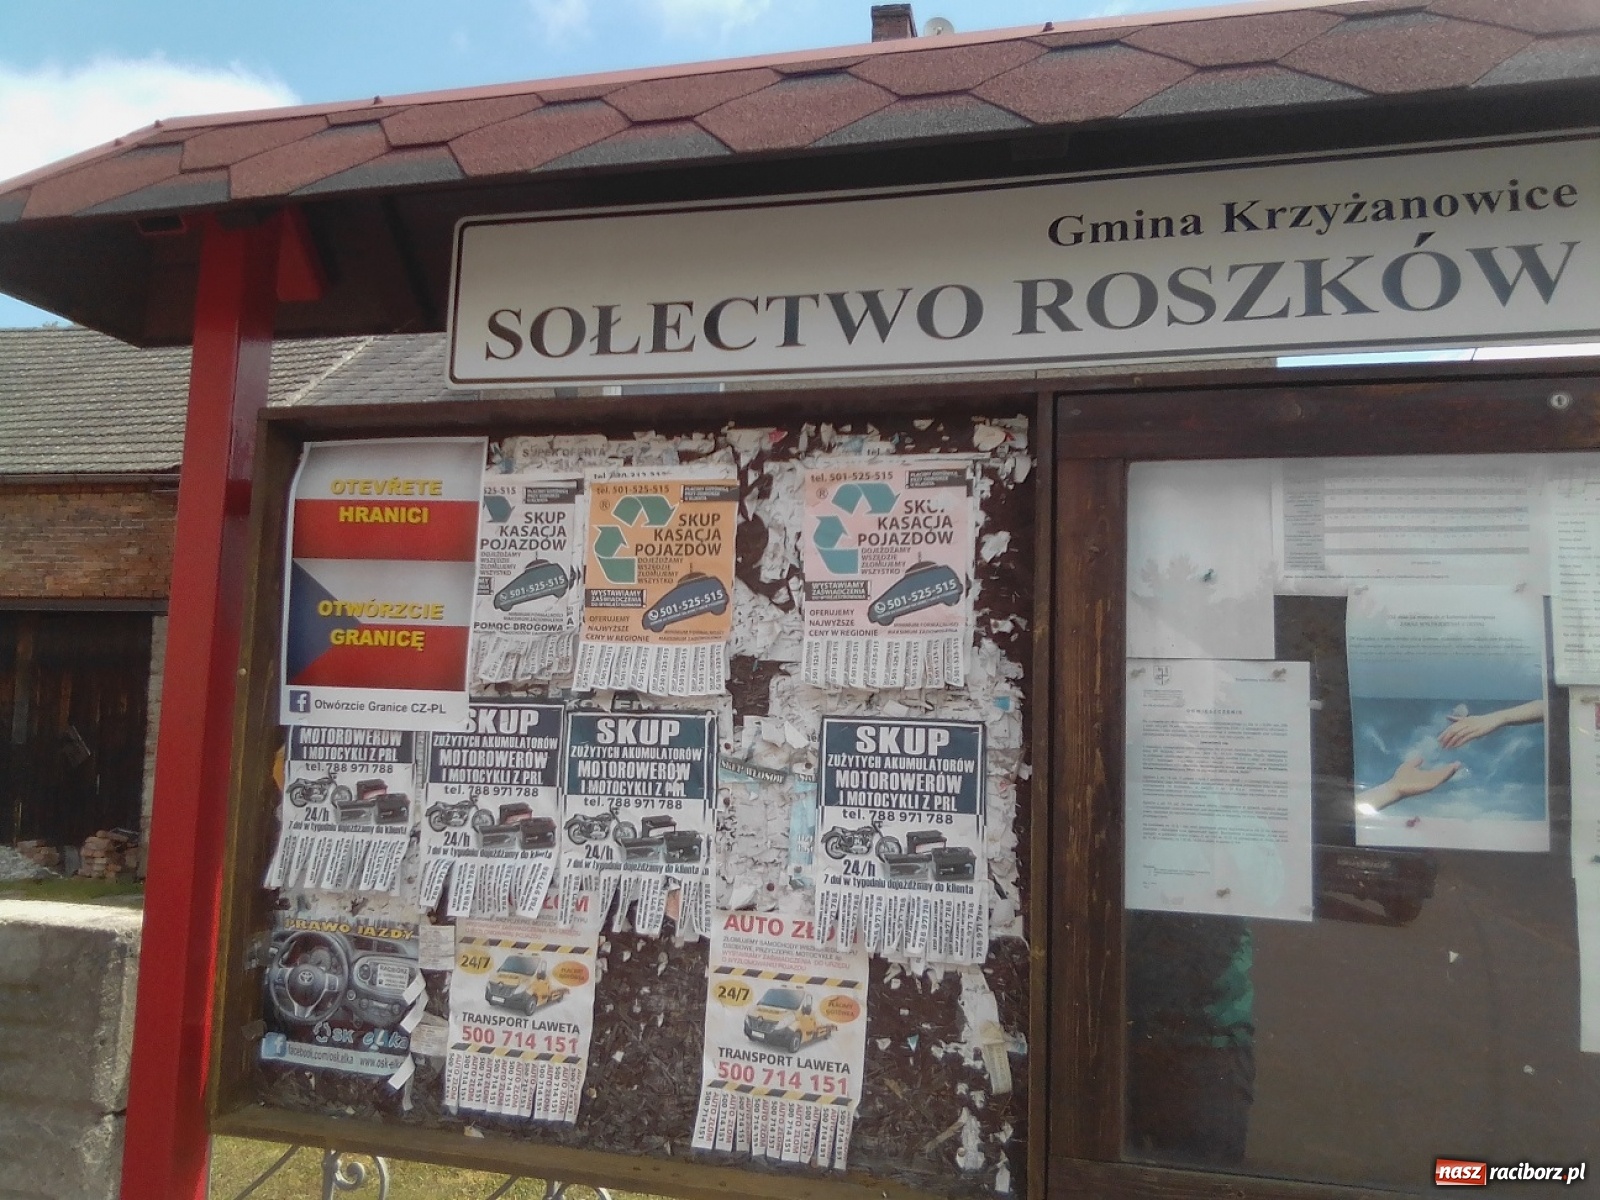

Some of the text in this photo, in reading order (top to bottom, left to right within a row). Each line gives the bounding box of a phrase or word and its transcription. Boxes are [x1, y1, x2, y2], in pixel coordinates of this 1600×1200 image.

[1048, 179, 1578, 247] Gmina Krzyżanowice
[485, 231, 1581, 361] SOŁECTWO ROSZKÓW
[829, 471, 893, 482] 501-525-515
[330, 477, 443, 496] OTEVŘETE
[613, 484, 670, 494] 501-525-515
[338, 505, 429, 524] HRANICI
[524, 512, 566, 524] SKUP
[679, 513, 721, 527] SKUP
[878, 515, 953, 530] KASACJA
[500, 525, 567, 537] KASACJA
[653, 528, 721, 542] KASACJA
[858, 530, 954, 547] POJAZDÓW
[480, 537, 567, 551] POJAZDÓW
[635, 541, 721, 556] POJAZDÓW
[887, 579, 957, 610] 501-525-515
[317, 599, 445, 620] OTWÓRZCIE
[660, 590, 723, 617] 501-525-515
[473, 621, 564, 632] POMOC DROGOWA
[329, 628, 426, 651] GRANICĘ
[314, 699, 365, 711] Otwórzcie
[368, 701, 408, 713] Granice
[411, 703, 446, 714] CZ-PL
[468, 708, 539, 735] SKUP
[597, 718, 680, 745] SKUP
[433, 734, 558, 750] ZUŻYTYCH AKUMULATORÓW
[856, 725, 950, 756] SKUP
[309, 747, 369, 760] MOTOCYKLI
[369, 748, 377, 761] Z
[379, 748, 398, 762] PRL
[439, 748, 549, 769] MOTOROWERÓW
[570, 744, 702, 761] ZUŻYTYCH AKUMULATORÓW
[305, 763, 393, 773] tel. 788 971 788
[578, 760, 691, 780] MOTOROWERÓW
[828, 753, 975, 773] ZUŻYTYCH AKUMULATORÓW
[448, 769, 511, 784] MOTOCYKLI
[511, 770, 520, 784] Z
[522, 771, 543, 785] PRL
[835, 769, 963, 794] MOTOROWERÓW
[444, 785, 539, 797] tel. 788 971 788
[588, 780, 652, 796] MOTOCYKLI
[654, 782, 662, 796] Z
[584, 797, 683, 810] tel. 788 971 788
[847, 791, 919, 808] MOTOCYKLI
[922, 794, 930, 810] Z
[934, 796, 957, 812] PRL
[305, 807, 329, 822] 24/h
[842, 809, 953, 824] tel. 788 971 788
[443, 832, 470, 847] 24/h
[585, 844, 613, 860] 24/h
[843, 859, 876, 877] 24/h
[723, 914, 784, 937] AUTO
[461, 955, 490, 970] 24/7
[718, 985, 750, 1001] 24/7
[462, 1012, 580, 1034] TRANSPORT LAWETA
[462, 1026, 579, 1054] 500 714 151
[718, 1047, 850, 1074] TRANSPORT LAWETA
[718, 1062, 848, 1095] 500 714 151
